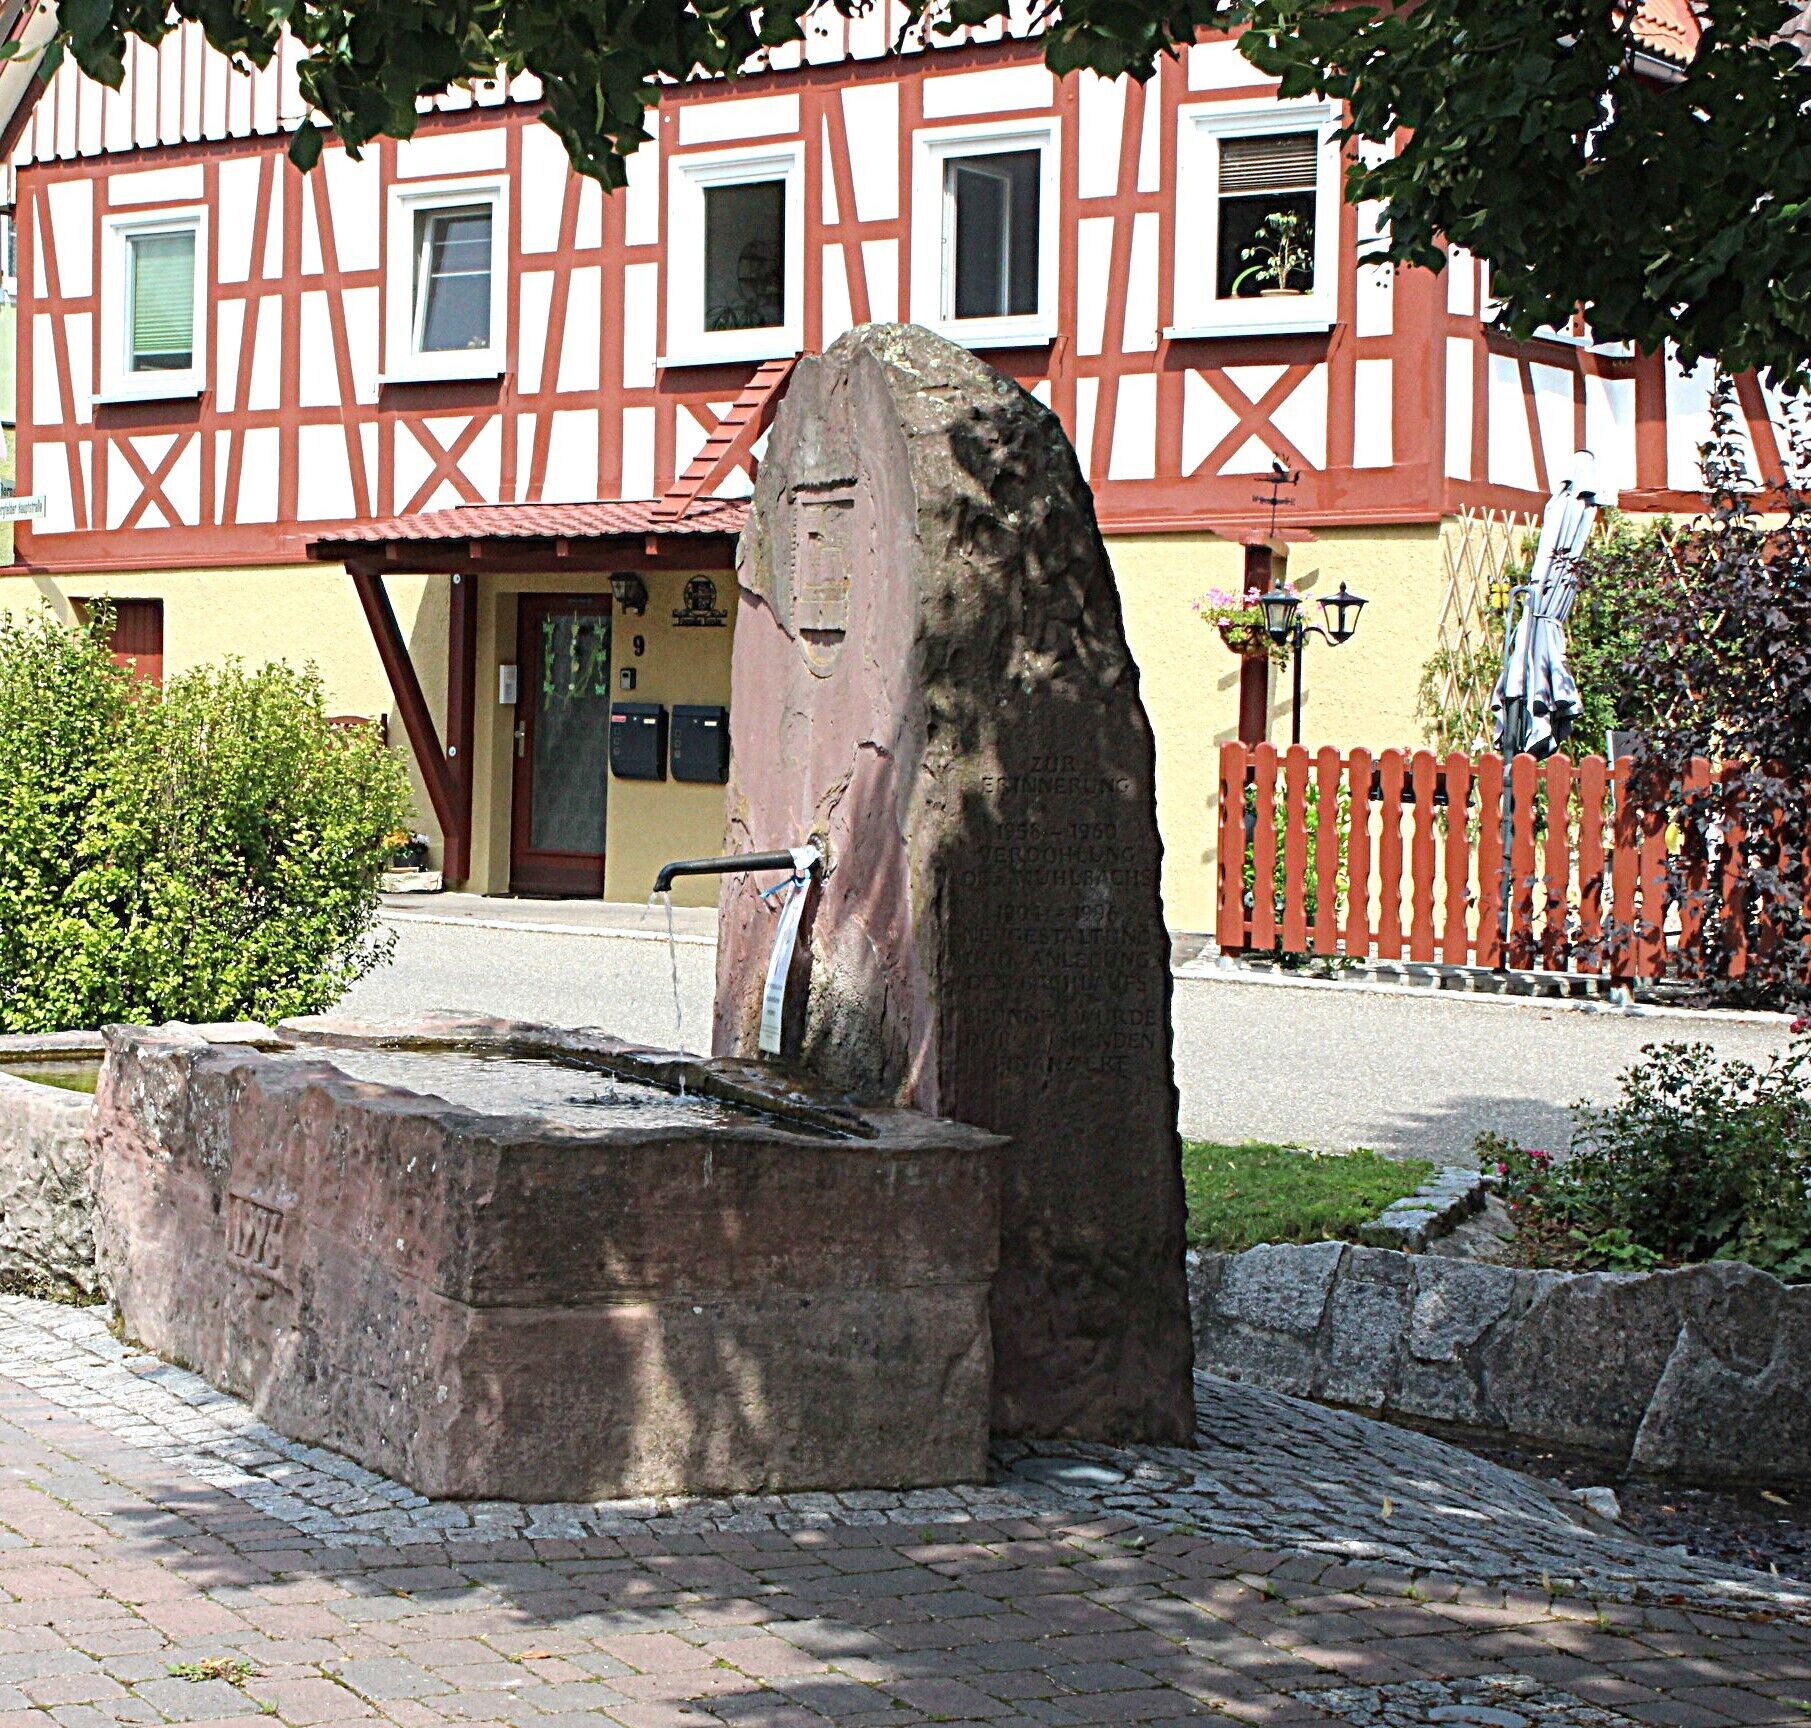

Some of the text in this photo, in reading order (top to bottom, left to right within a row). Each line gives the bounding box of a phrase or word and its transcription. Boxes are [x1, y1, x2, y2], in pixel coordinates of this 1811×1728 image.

[633, 635, 645, 656] 9
[1031, 755, 1075, 773] ZUR
[982, 776, 1130, 794] ERINNERUNG
